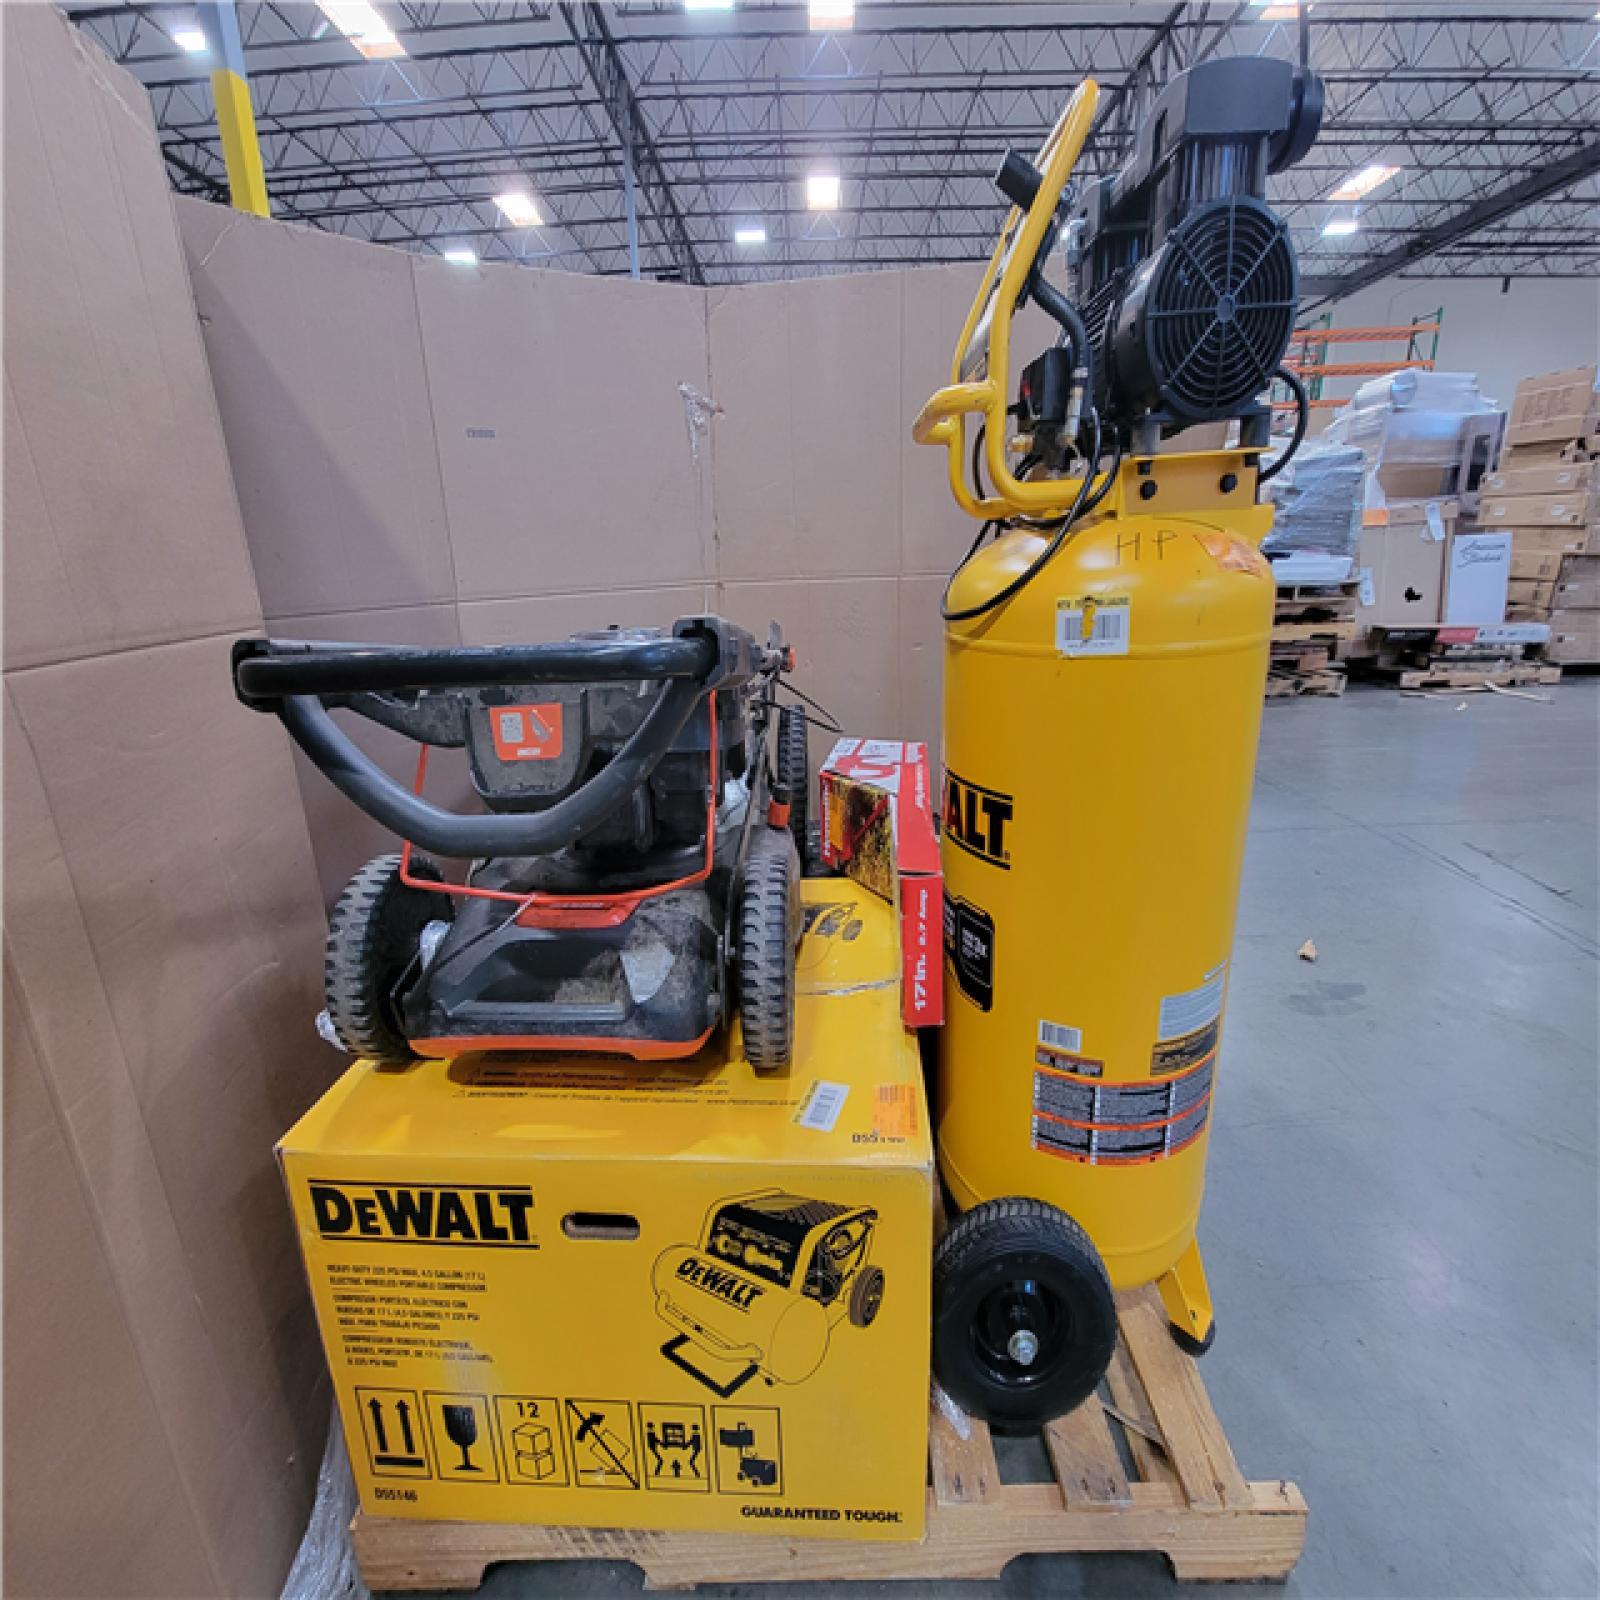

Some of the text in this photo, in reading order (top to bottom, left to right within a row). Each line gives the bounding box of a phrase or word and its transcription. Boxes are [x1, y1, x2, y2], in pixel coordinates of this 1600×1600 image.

[310, 1186, 535, 1241] DEWALT
[516, 1401, 541, 1419] 12
[741, 1505, 840, 1521] GUARANTEED
